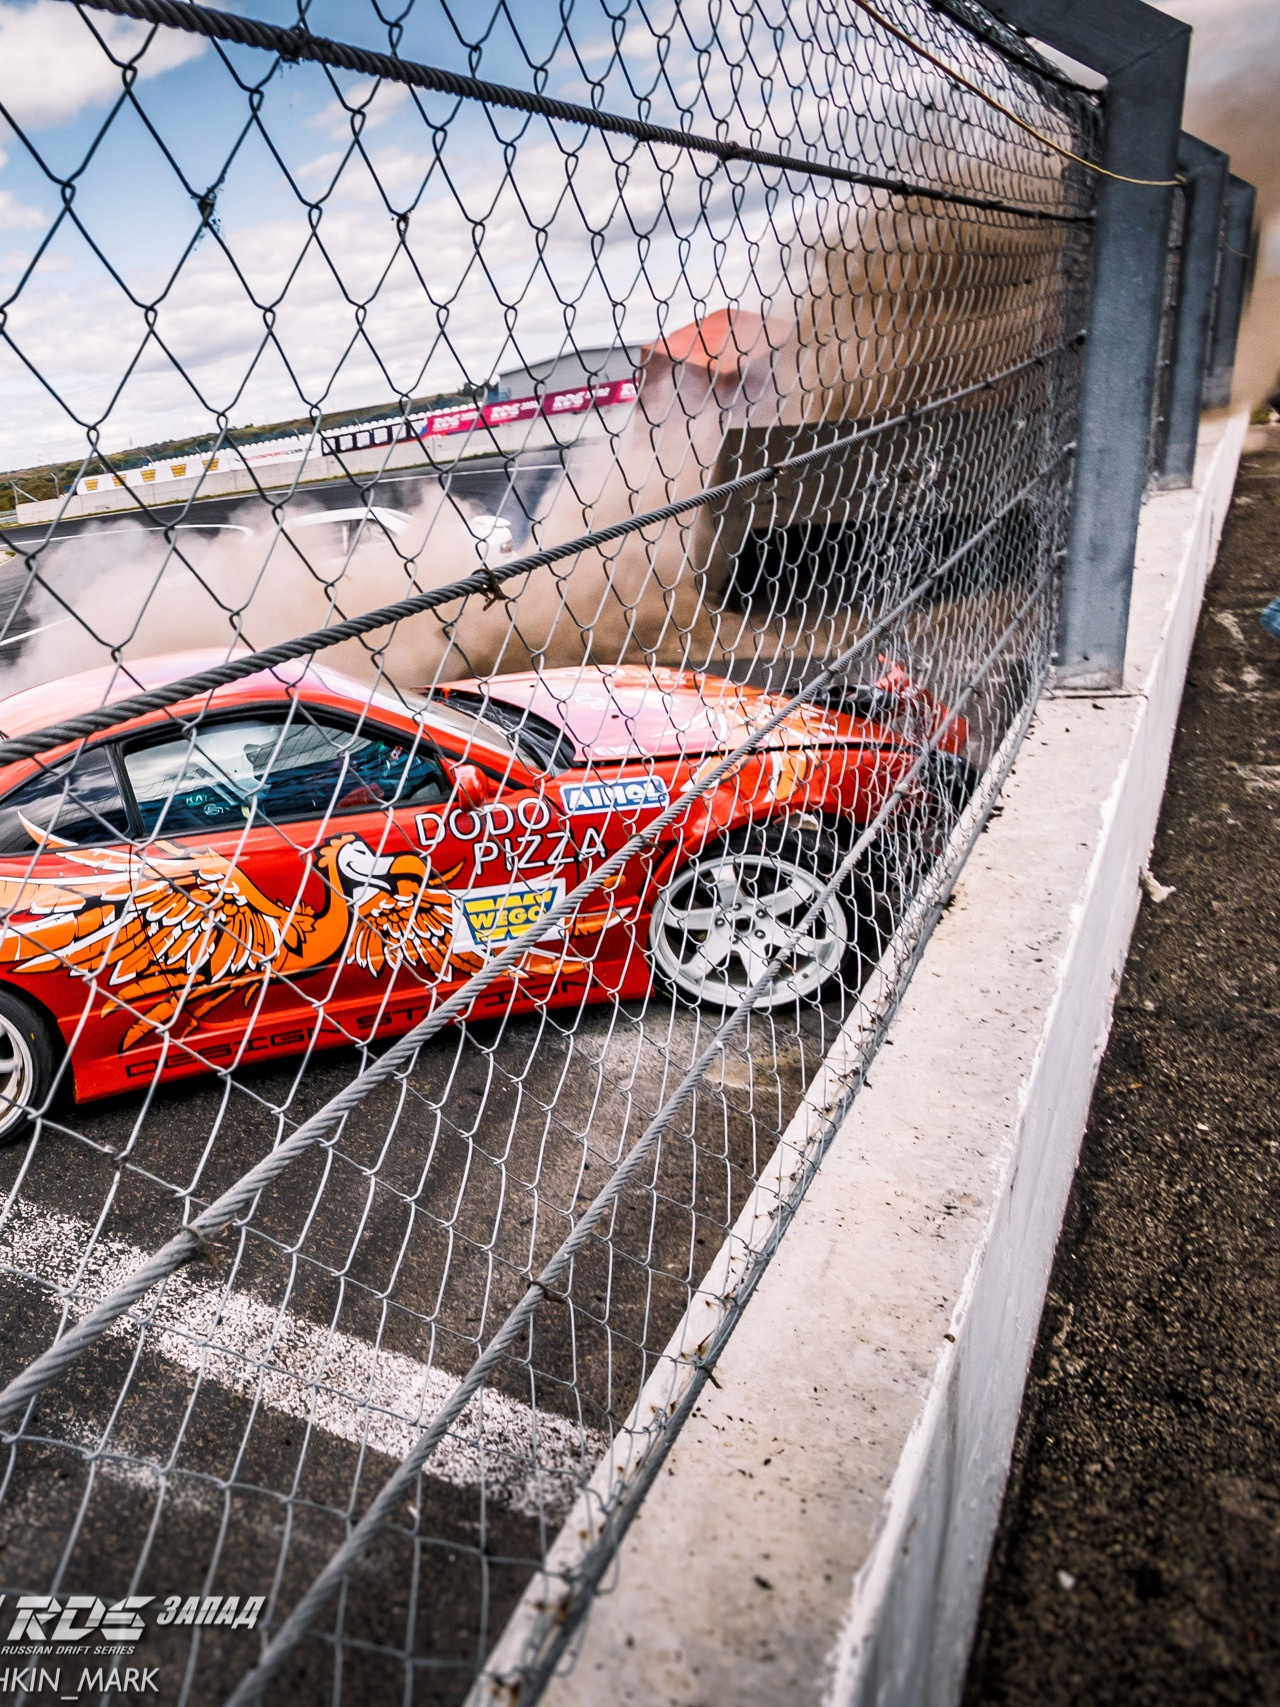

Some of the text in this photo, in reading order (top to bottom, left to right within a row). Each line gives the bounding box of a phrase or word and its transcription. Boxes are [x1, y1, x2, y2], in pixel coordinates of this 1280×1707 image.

[569, 782, 662, 809] AIMOL
[415, 797, 550, 846] DODO
[474, 827, 607, 875] PIZZA
[469, 905, 547, 930] WEGO
